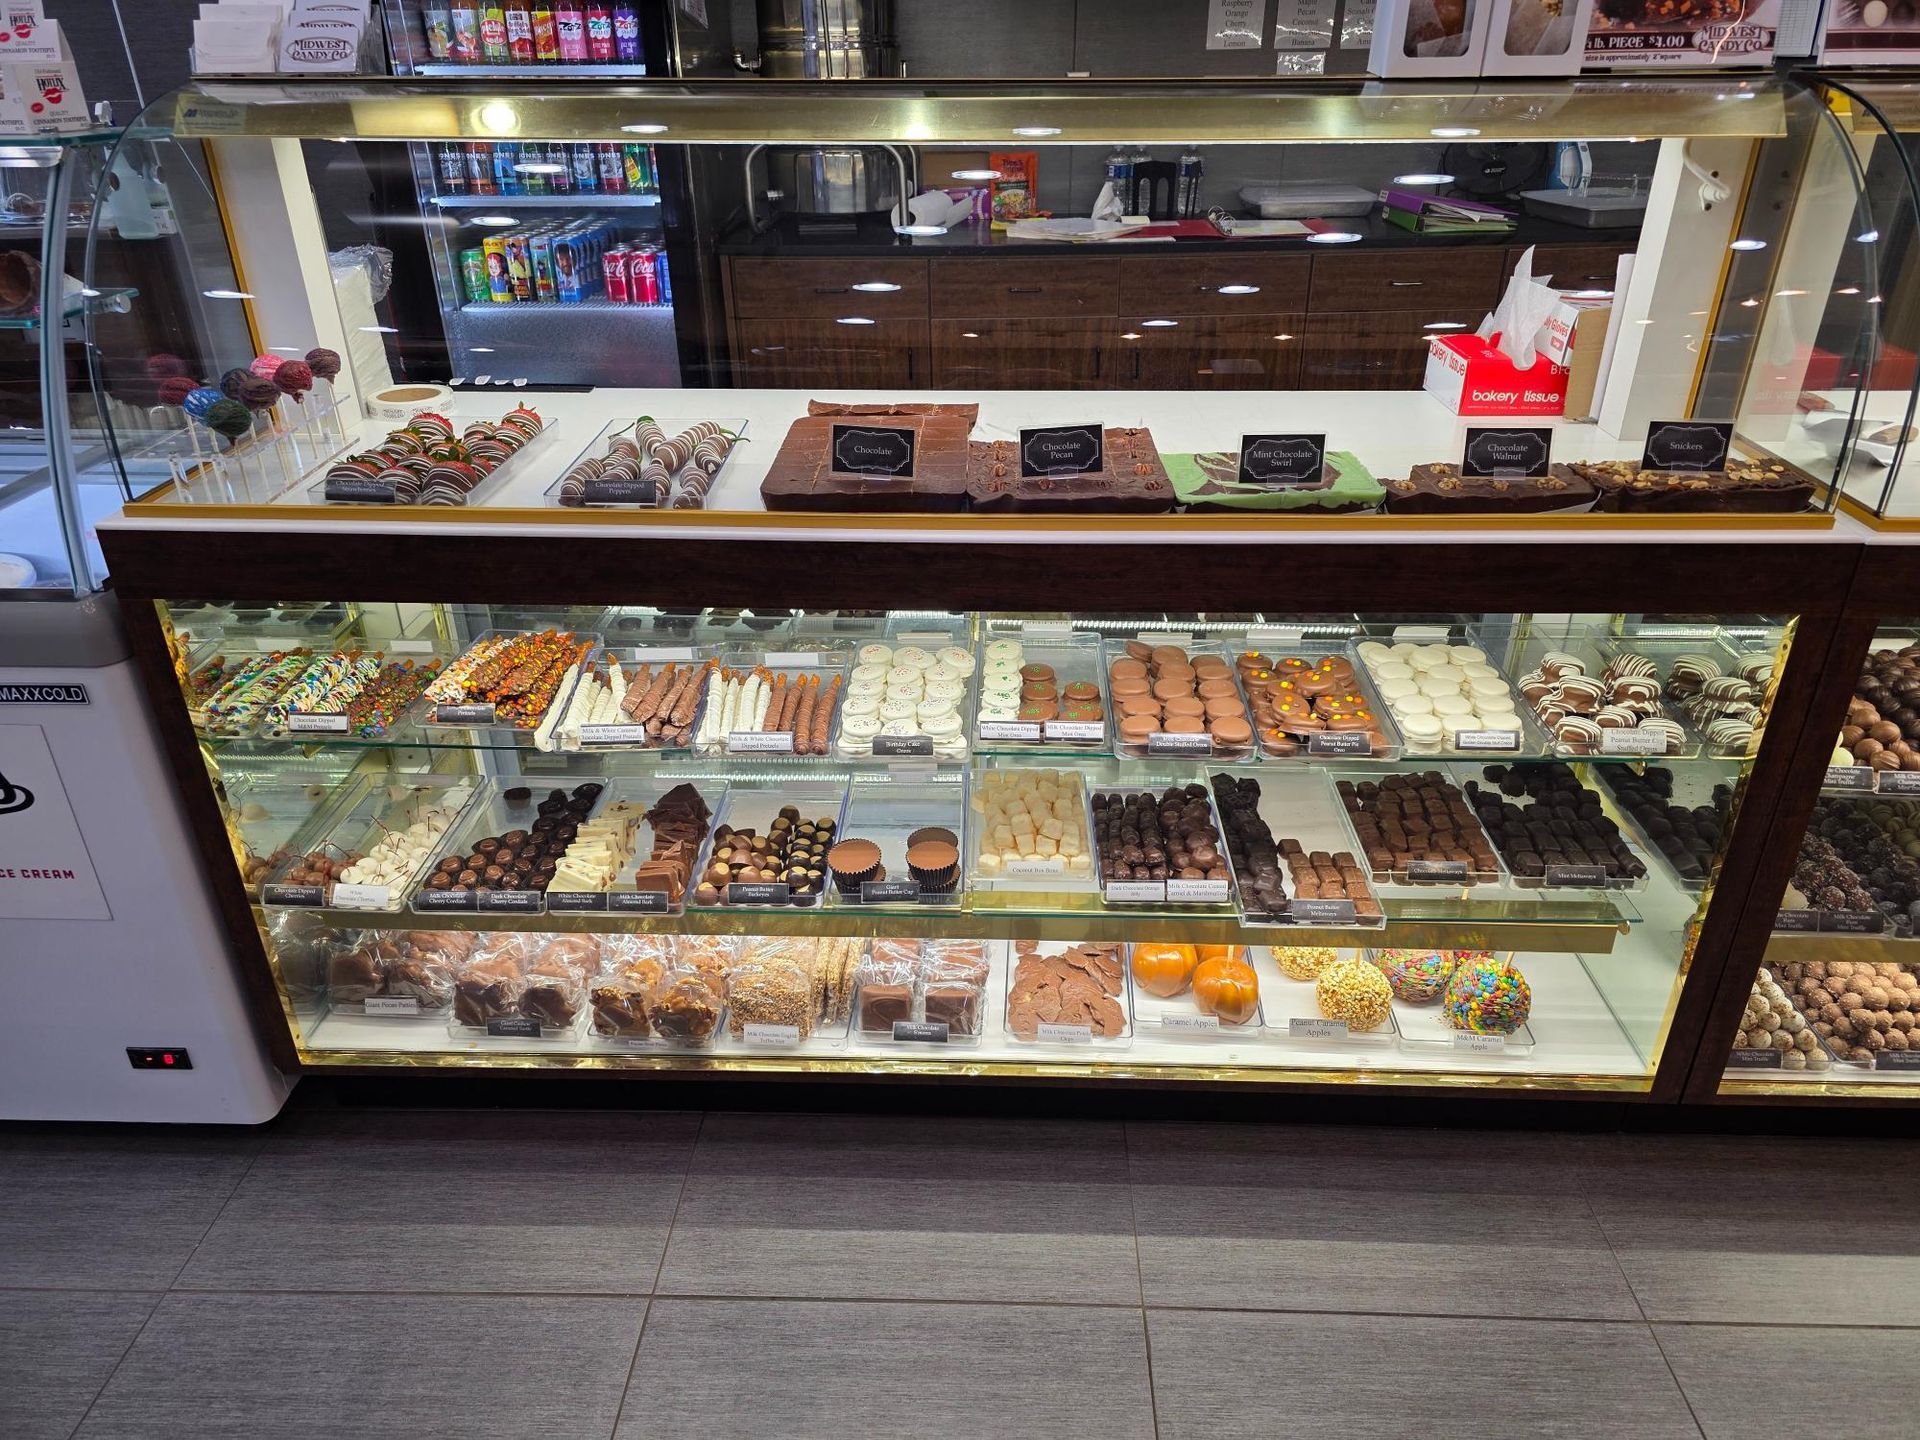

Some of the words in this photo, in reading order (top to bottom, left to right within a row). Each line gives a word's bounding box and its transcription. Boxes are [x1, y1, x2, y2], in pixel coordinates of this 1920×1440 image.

[1225, 9, 1249, 17] Orange
[1225, 19, 1246, 27] Cherry
[295, 39, 347, 50] MIDWEST
[1223, 40, 1246, 48] Lemon
[1609, 37, 1644, 47] PIECE
[292, 51, 329, 62] CANDY
[1449, 353, 1466, 378] tissue
[1472, 389, 1519, 404] bakery
[1523, 389, 1560, 403] tissue
[854, 445, 893, 456] Chocolate
[1042, 442, 1081, 451] Chocolate
[1487, 443, 1529, 452] Chocolate
[1669, 441, 1704, 451] Snickers
[1050, 450, 1074, 459] Pecan
[1253, 450, 1272, 459] Mint
[1273, 450, 1313, 459] Chocolate
[1492, 452, 1522, 461] Walnut
[1271, 458, 1293, 467] Swirl
[623, 482, 645, 490] Dipped
[318, 716, 336, 724] Dipped
[1021, 725, 1039, 733] Dipped
[1084, 724, 1102, 732] Dipped
[741, 742, 760, 750] Dipped
[21, 869, 75, 880] CREAM
[298, 887, 317, 895] Dipped
[1162, 1016, 1193, 1027] Caramel
[1194, 1018, 1217, 1029] Apples
[1290, 1018, 1315, 1026] Peanut
[1316, 1019, 1347, 1028] Caramel
[1305, 1029, 1332, 1038] Apples
[1471, 1043, 1488, 1051] Apple
